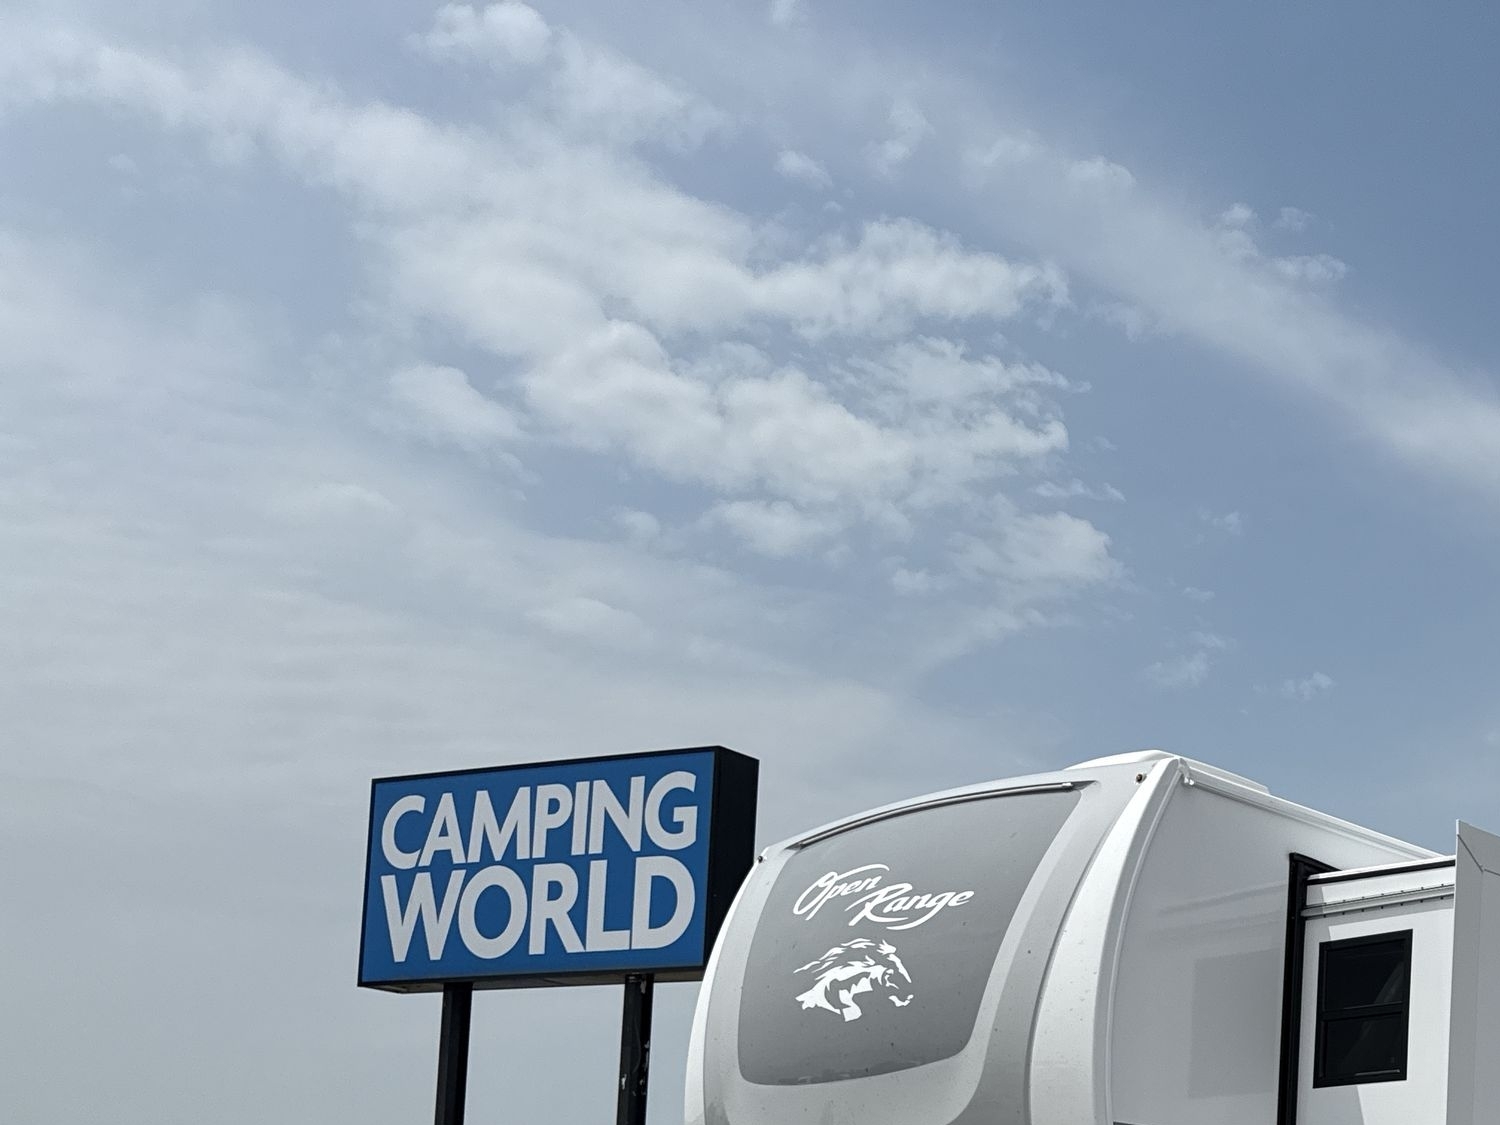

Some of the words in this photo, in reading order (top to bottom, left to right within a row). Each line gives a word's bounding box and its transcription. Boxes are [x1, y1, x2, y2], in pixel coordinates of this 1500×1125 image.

[381, 771, 698, 870] CAMPING
[381, 855, 696, 963] WORLD
[793, 863, 890, 921] Open
[844, 882, 975, 931] Range
